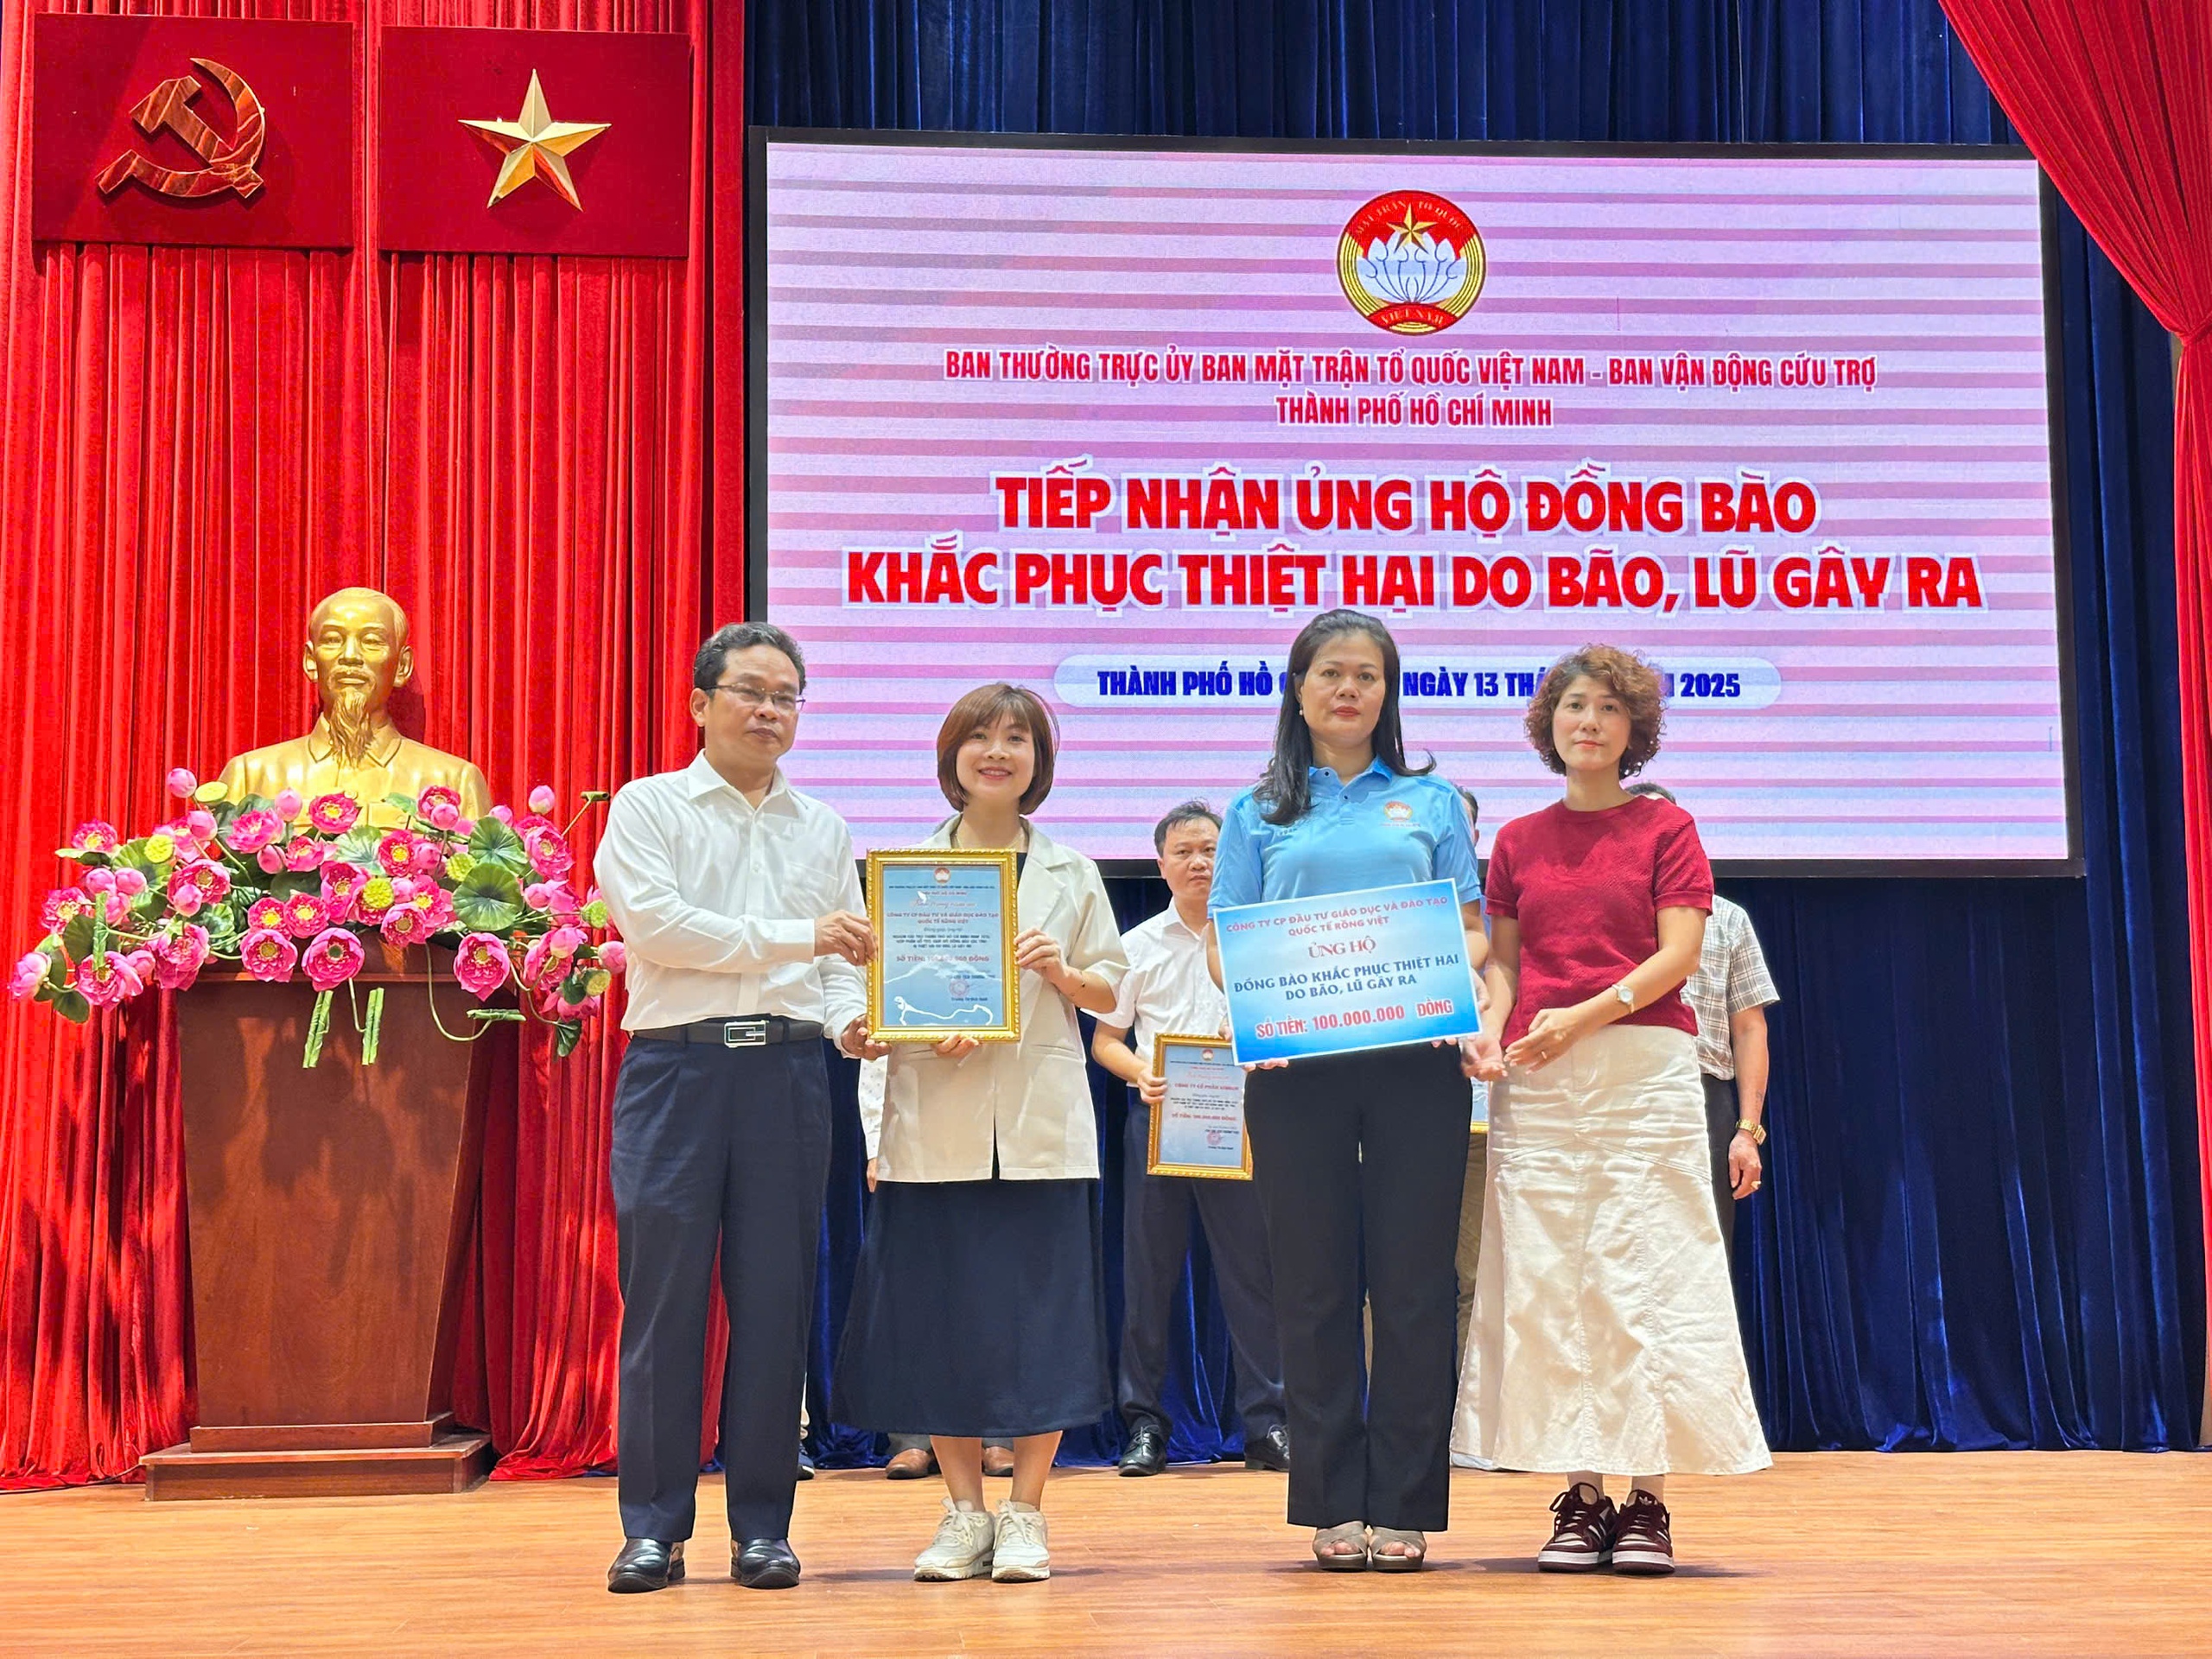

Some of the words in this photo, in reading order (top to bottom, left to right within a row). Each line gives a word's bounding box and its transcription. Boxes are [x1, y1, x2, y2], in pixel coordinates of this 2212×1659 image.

[947, 352, 990, 378] BAN
[999, 345, 1090, 379] THƯỜNG
[1099, 353, 1157, 385] TRỰC
[1166, 346, 1192, 380] ỦY
[1203, 355, 1245, 381] BAN
[1255, 351, 1304, 386] MẶT
[1313, 350, 1368, 387] TRẬN
[1376, 348, 1405, 383] TỔ
[1411, 350, 1470, 385] QUỐC
[1478, 352, 1523, 390] VIỆT
[1533, 359, 1583, 384] NAM
[1610, 359, 1652, 385] BAN
[1662, 353, 1704, 390] VẬN
[1713, 353, 1771, 391] ĐỘNG
[1780, 353, 1826, 385] CỨU
[1834, 358, 1875, 391] TRỢ
[1277, 392, 1349, 423] THÀNH
[1357, 391, 1404, 424] PHỐ
[1409, 391, 1440, 425] HỒ
[1448, 395, 1483, 425] CHÍ
[1493, 400, 1551, 425] MINH
[996, 455, 1110, 528] TIẾP
[1128, 467, 1279, 535] NHẬN
[1297, 467, 1412, 531] ỦNG
[1431, 470, 1510, 537] HỘ
[1526, 466, 1682, 532] ĐỒNG
[1701, 474, 1815, 532] BÀO
[849, 537, 997, 604] KHẮC
[1015, 554, 1162, 611] PHỤC
[1179, 544, 1325, 612] THIỆT
[1343, 556, 1433, 612] HẠI
[1452, 556, 1531, 607] DO
[1548, 550, 1678, 612] BÃO,
[1694, 550, 1756, 607] LŨ
[1774, 547, 1890, 607] GÂY
[1907, 557, 1981, 607] RA
[1097, 665, 1176, 695] THÀNH
[1183, 661, 1232, 696] PHỐ
[1239, 661, 1272, 696] HỒ
[1403, 667, 1468, 696] NGÀY
[1474, 673, 1498, 696] 13
[1681, 673, 1740, 696] 2025
[1257, 918, 1270, 927] TY
[1314, 911, 1328, 920] TƯ
[1360, 905, 1381, 916] DỤC
[1383, 900, 1398, 912] VÀ
[1426, 896, 1448, 907] TẠO
[1350, 935, 1376, 954] HỘ
[1279, 973, 1308, 987] BÀO
[1354, 963, 1390, 977] PHỤC
[1286, 988, 1306, 1001] DO
[1346, 979, 1363, 993] LŨ
[1367, 976, 1394, 989] GÂY
[1398, 974, 1417, 986] RA
[1313, 1005, 1405, 1030] 100.000.000
[1417, 997, 1452, 1017] ĐỒNG
